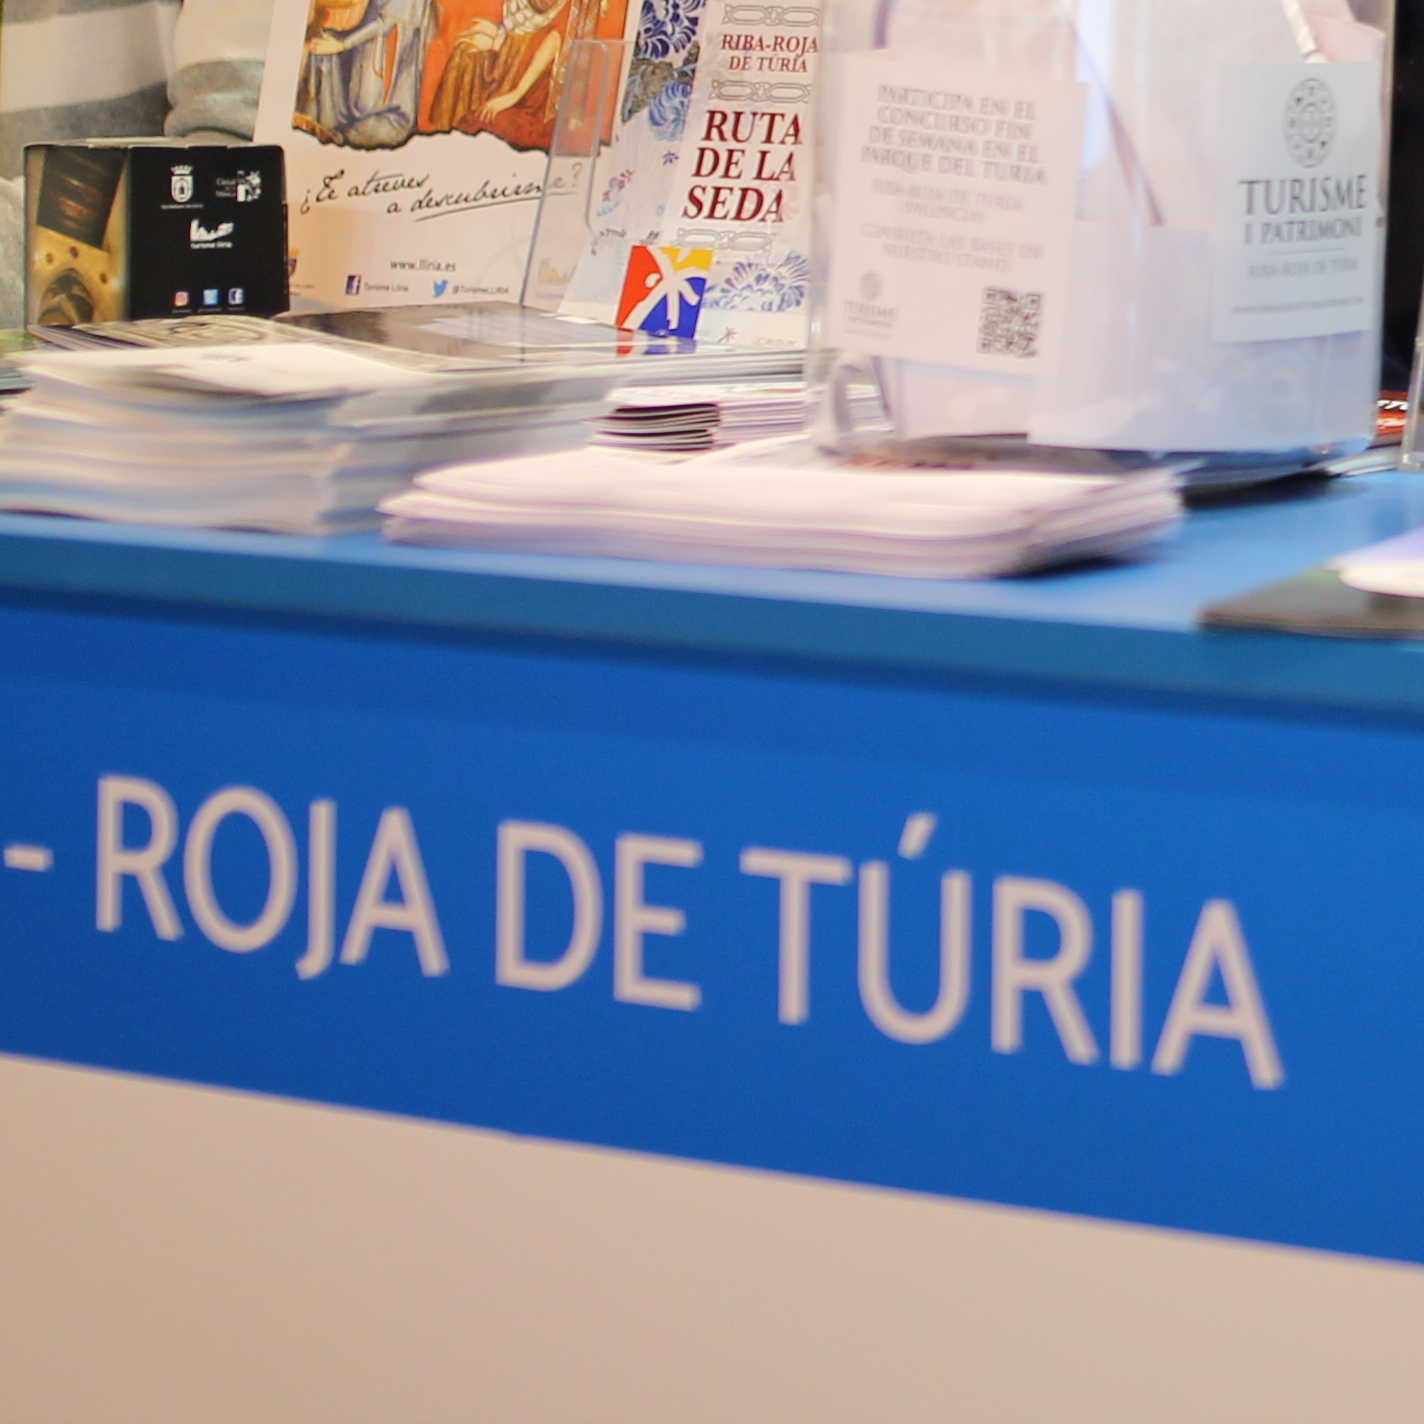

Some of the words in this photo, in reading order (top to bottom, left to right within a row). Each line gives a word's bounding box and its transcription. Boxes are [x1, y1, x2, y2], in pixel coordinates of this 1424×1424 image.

[721, 33, 819, 57] RIBA-ROJA
[728, 56, 751, 71] DE
[701, 109, 804, 146] RUTA
[691, 147, 743, 179] DE
[753, 149, 797, 183] LA
[386, 200, 401, 214] a
[682, 184, 785, 223] SEDA
[1239, 174, 1368, 216] TURISME
[94, 773, 450, 981] ROJA
[493, 819, 702, 1012] DE
[737, 812, 1285, 1090] TÚRIA
